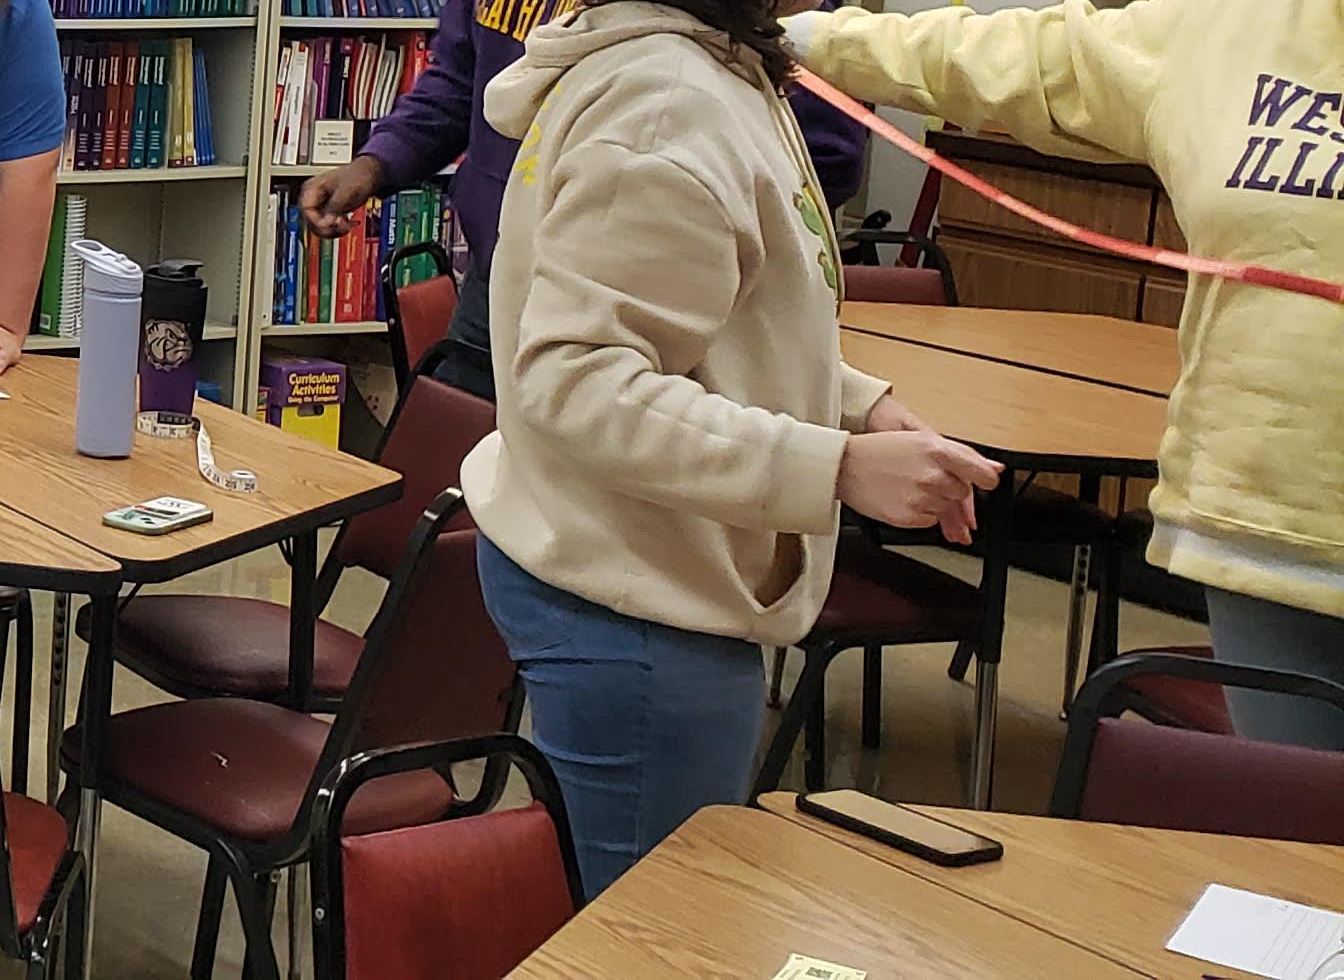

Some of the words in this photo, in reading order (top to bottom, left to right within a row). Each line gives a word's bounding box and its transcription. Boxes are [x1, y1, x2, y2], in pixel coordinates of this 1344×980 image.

[1247, 73, 1344, 144] WE
[1224, 136, 1344, 200] ILLI
[388, 218, 396, 245] Math
[288, 372, 340, 385] Curriculum
[291, 384, 336, 396] Activities
